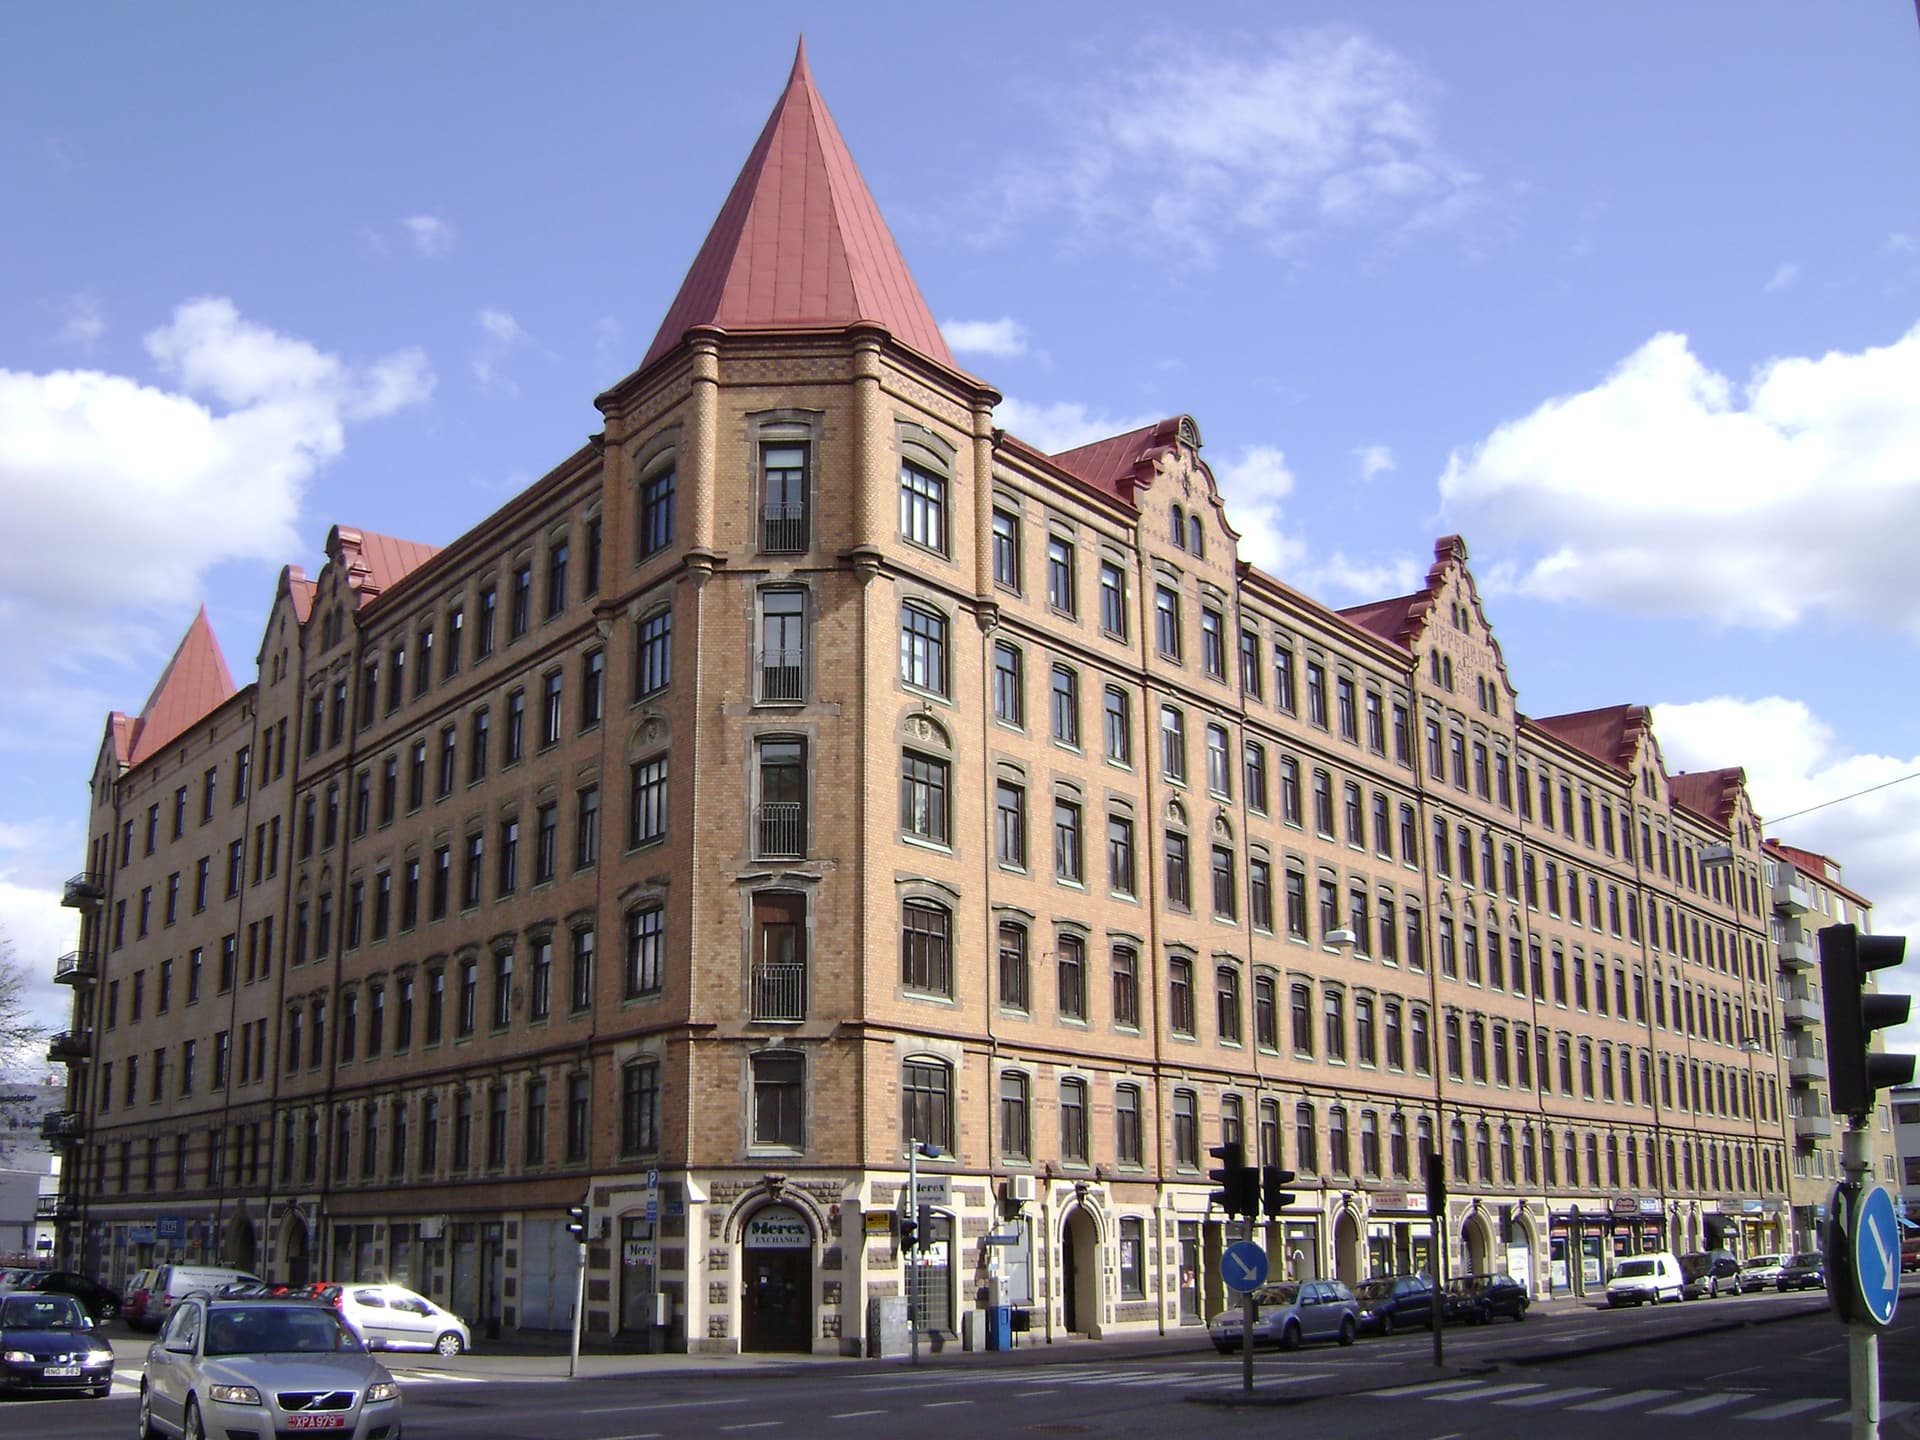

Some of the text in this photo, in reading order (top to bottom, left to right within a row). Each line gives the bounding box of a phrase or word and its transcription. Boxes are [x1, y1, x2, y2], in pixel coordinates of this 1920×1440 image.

[648, 1171, 657, 1188] P
[751, 1221, 805, 1235] Merex
[755, 1236, 801, 1244] EXCHANGE
[296, 1415, 336, 1427] XPA979
